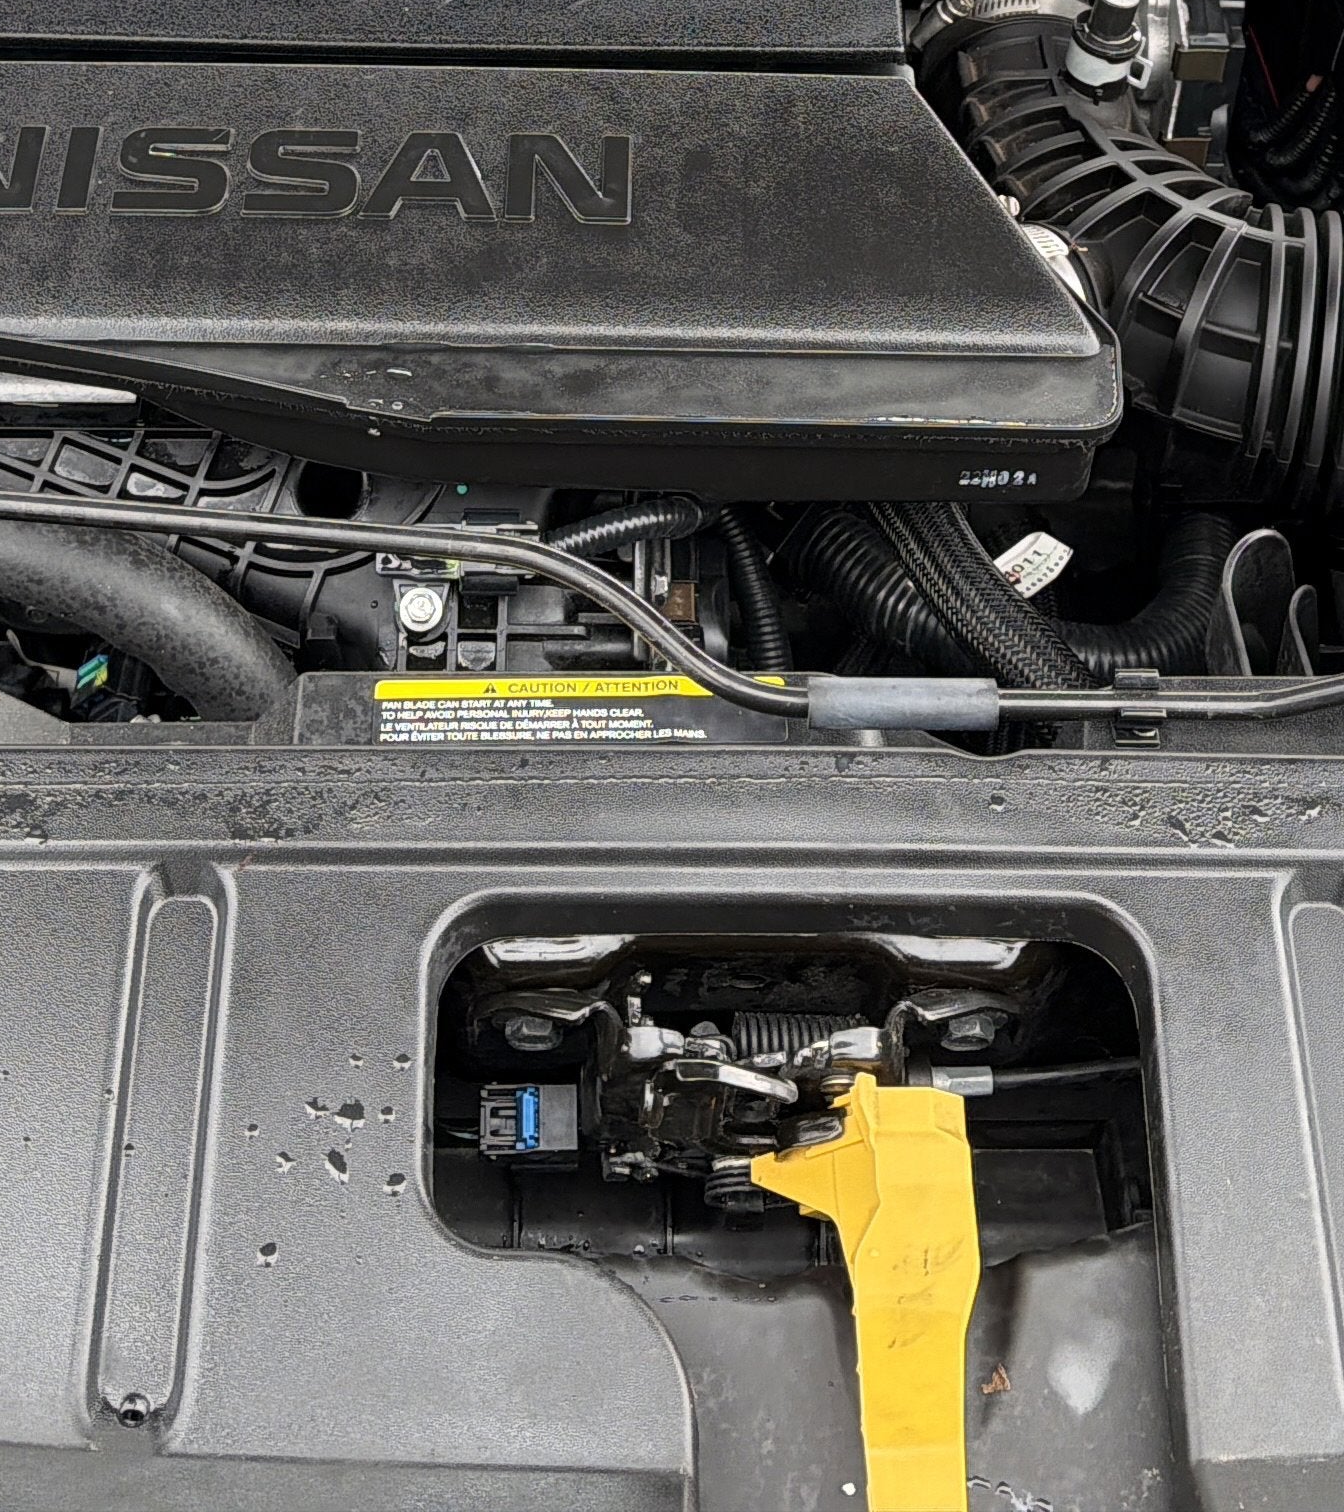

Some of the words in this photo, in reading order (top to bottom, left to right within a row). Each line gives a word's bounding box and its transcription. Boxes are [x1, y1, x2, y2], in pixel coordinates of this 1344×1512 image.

[508, 682, 577, 694] CAUTION
[594, 679, 679, 693] ATTENTION
[403, 701, 436, 710] BLADE
[437, 700, 460, 709] CAN
[461, 700, 492, 708] START
[493, 700, 505, 708] AT
[506, 699, 528, 708] ANY
[528, 699, 555, 708] TIME.
[381, 711, 396, 720] TO
[396, 711, 423, 719] HELP
[424, 710, 455, 719] AVOID
[456, 710, 510, 719] PERSONAL
[573, 708, 608, 717] HANDS
[380, 723, 394, 732] LE
[394, 722, 458, 731] VENTILATEUR
[460, 721, 499, 730] RISQUE
[499, 720, 514, 729] DE
[515, 719, 571, 729] DÉMARRER
[571, 718, 580, 729] À
[580, 719, 607, 728] TOUT
[608, 719, 654, 728] MOMENT.
[379, 733, 410, 742] POUR
[411, 731, 445, 742] ÉVITER
[446, 733, 479, 741] TOUTE
[536, 731, 551, 740] NE
[552, 730, 572, 739] PAS
[574, 730, 588, 739] EN
[589, 729, 652, 739] APPROCHER
[653, 728, 672, 738] LES
